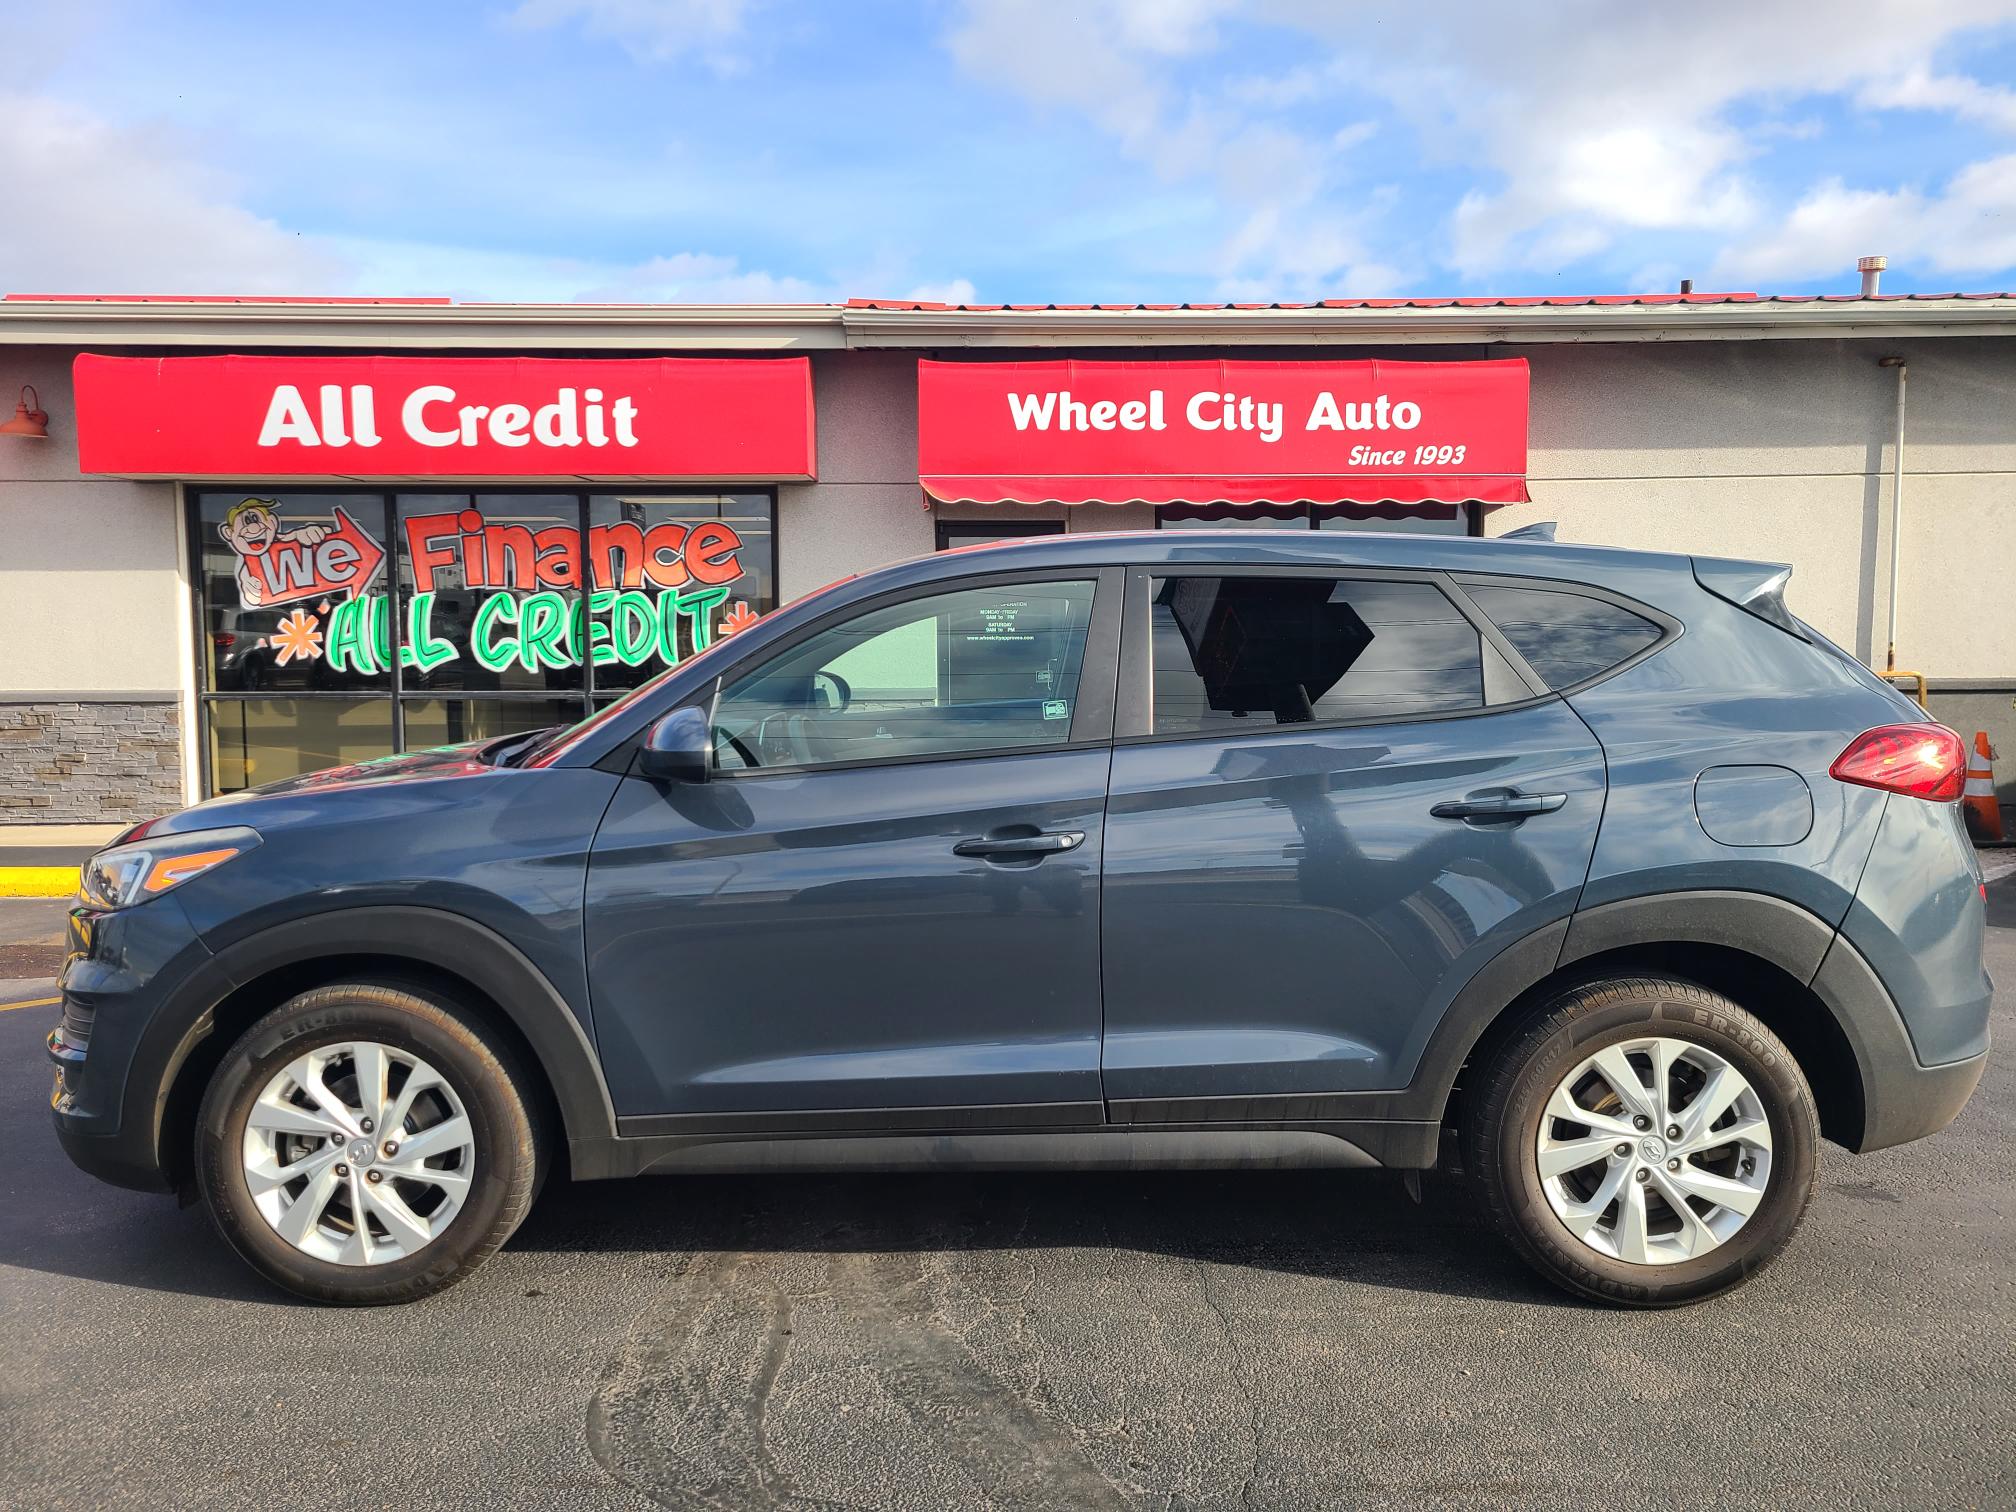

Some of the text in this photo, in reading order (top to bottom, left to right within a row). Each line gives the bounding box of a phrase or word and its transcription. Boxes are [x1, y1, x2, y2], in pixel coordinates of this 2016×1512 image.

[258, 384, 639, 447] All Credit
[1007, 390, 1422, 442] Wheel City Auto
[1348, 444, 1467, 466] Since 1993
[403, 507, 747, 594] Finance
[325, 586, 732, 676] ALL CREDIT
[1692, 1008, 1776, 1067] ER-800
